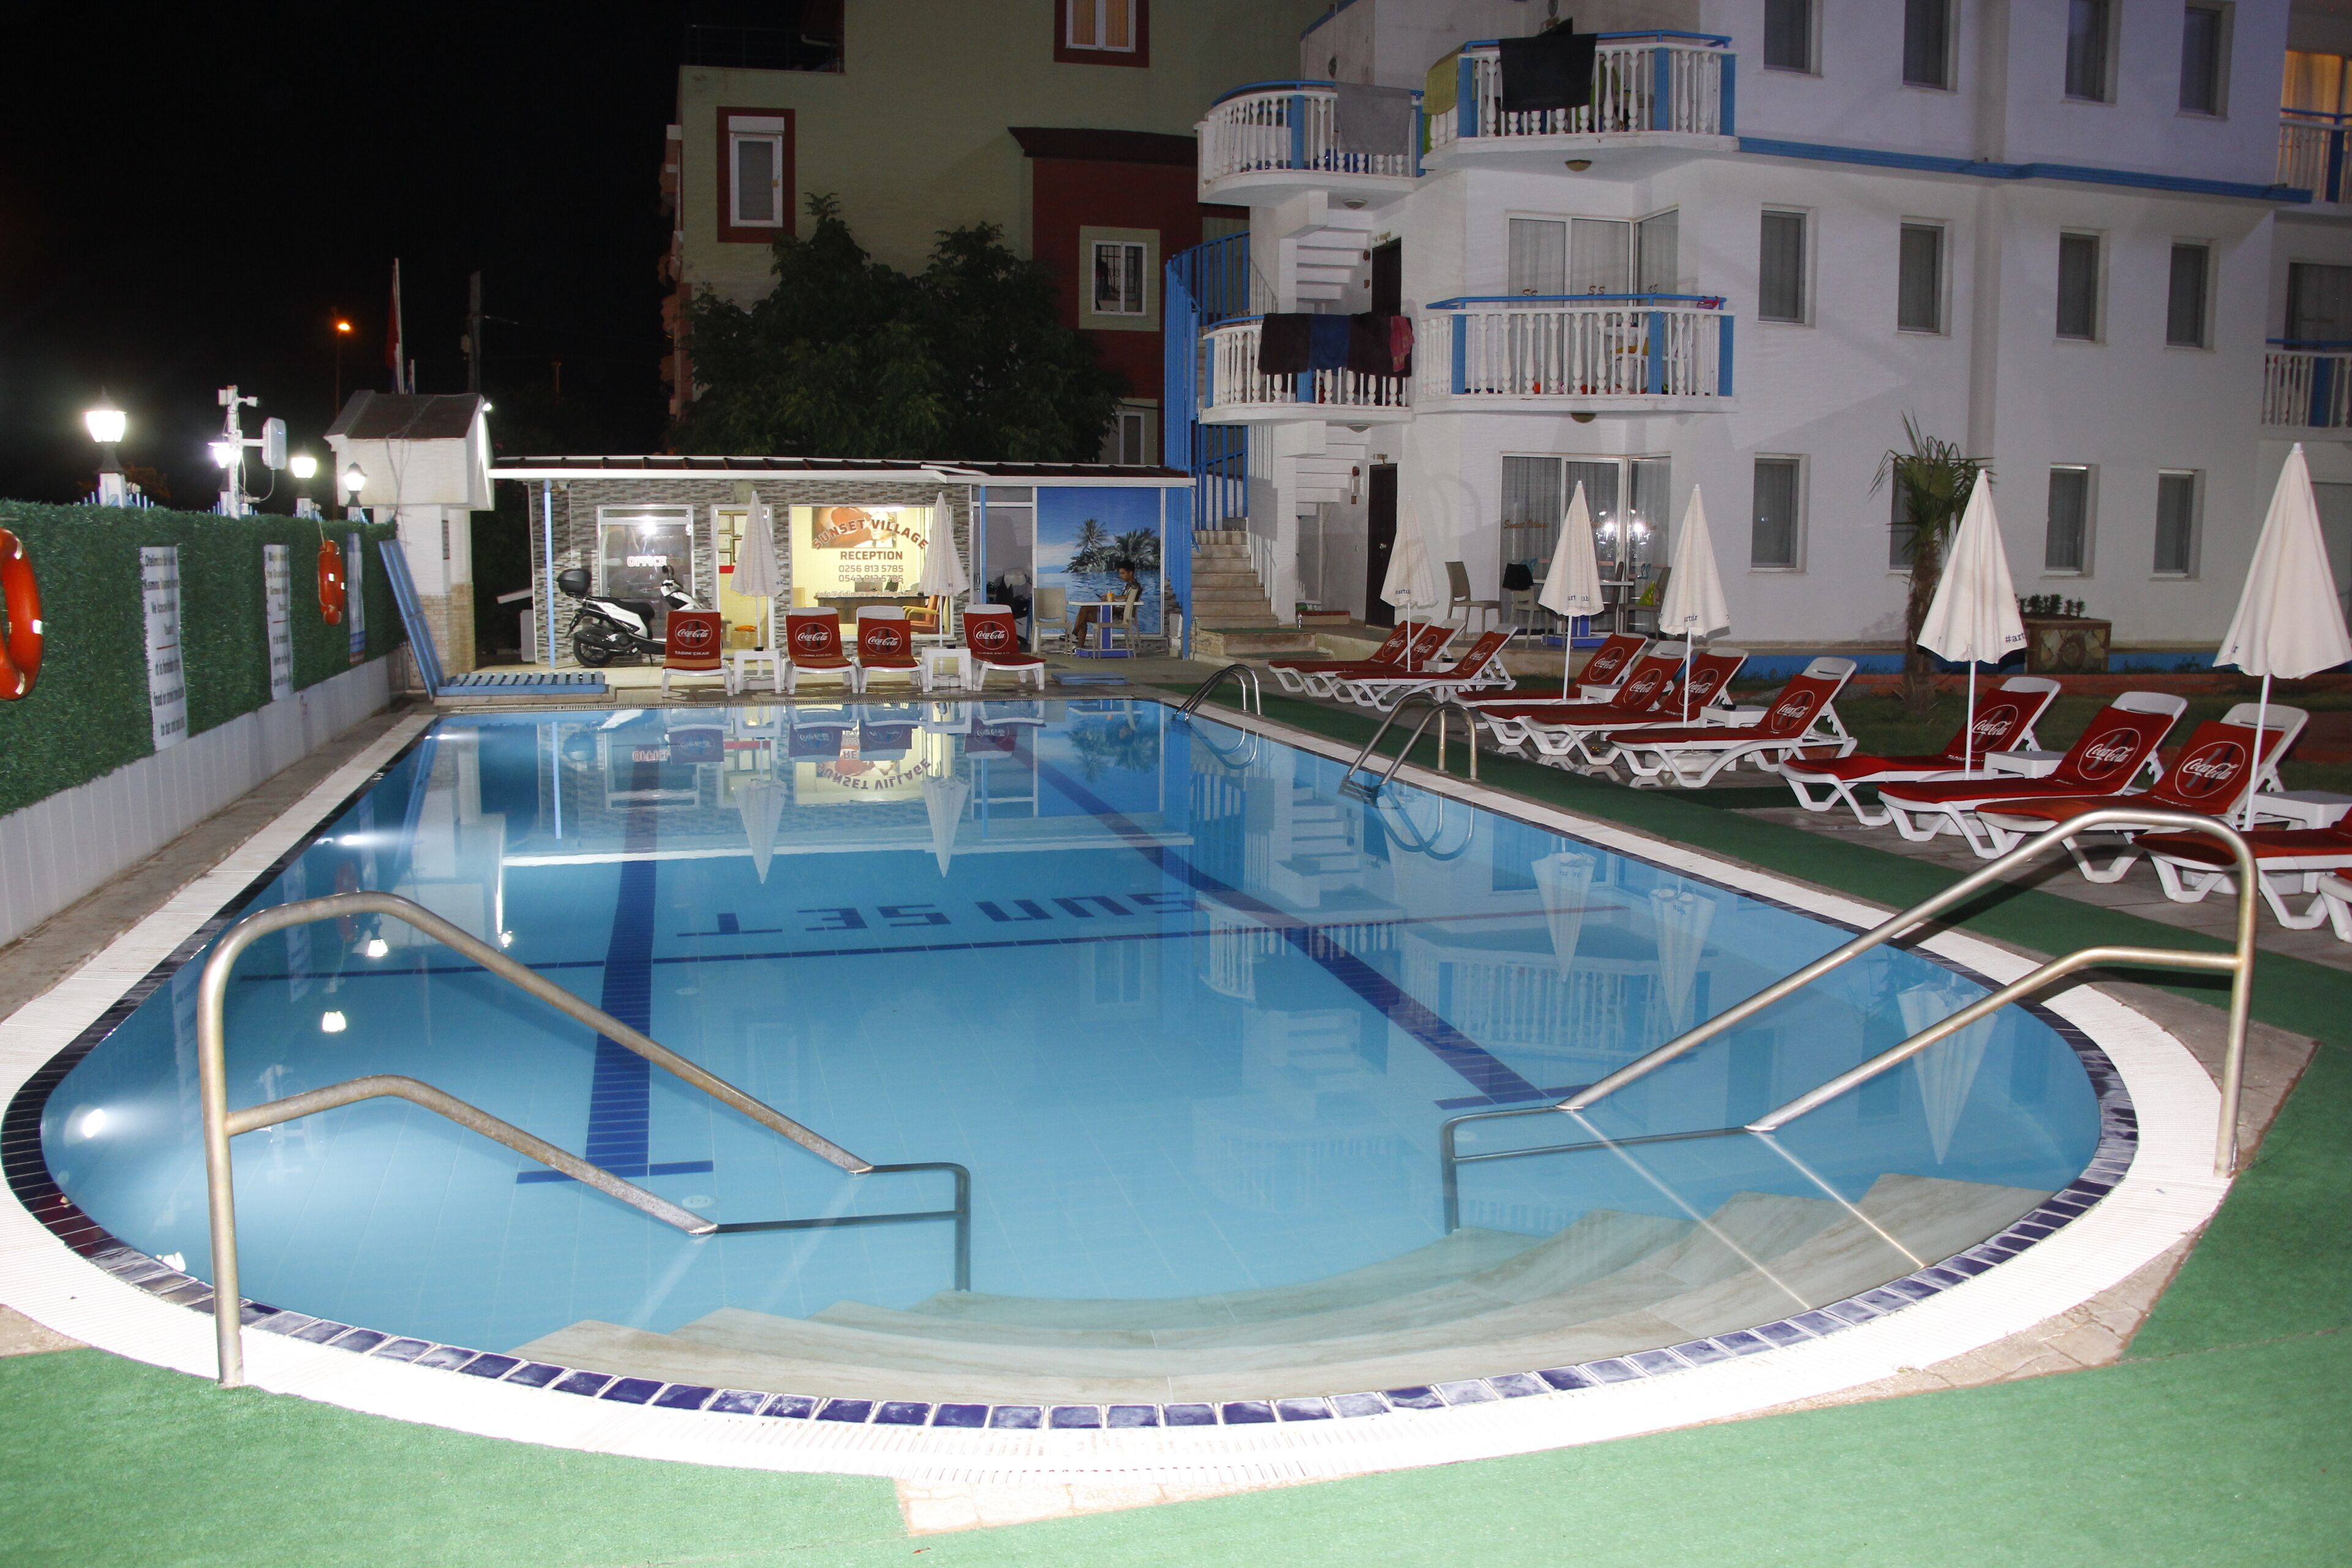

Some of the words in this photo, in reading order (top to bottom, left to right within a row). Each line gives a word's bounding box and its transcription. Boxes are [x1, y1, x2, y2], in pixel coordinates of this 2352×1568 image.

[812, 519, 865, 550] SUNSET
[872, 519, 929, 549] VILLAGE
[840, 551, 903, 560] RECEPTION
[627, 556, 668, 567] OFFICE
[677, 628, 710, 638] Coca-Cola
[797, 631, 829, 641] Coca-Cola
[976, 630, 1006, 639] Coca-Cola
[867, 636, 900, 646] Coca-Cola
[1776, 703, 1809, 718] Coca-Cola
[1972, 720, 2013, 736] Coca-Cola
[2086, 743, 2136, 763] Coca-Cola
[2182, 758, 2240, 780] Coca-Cola
